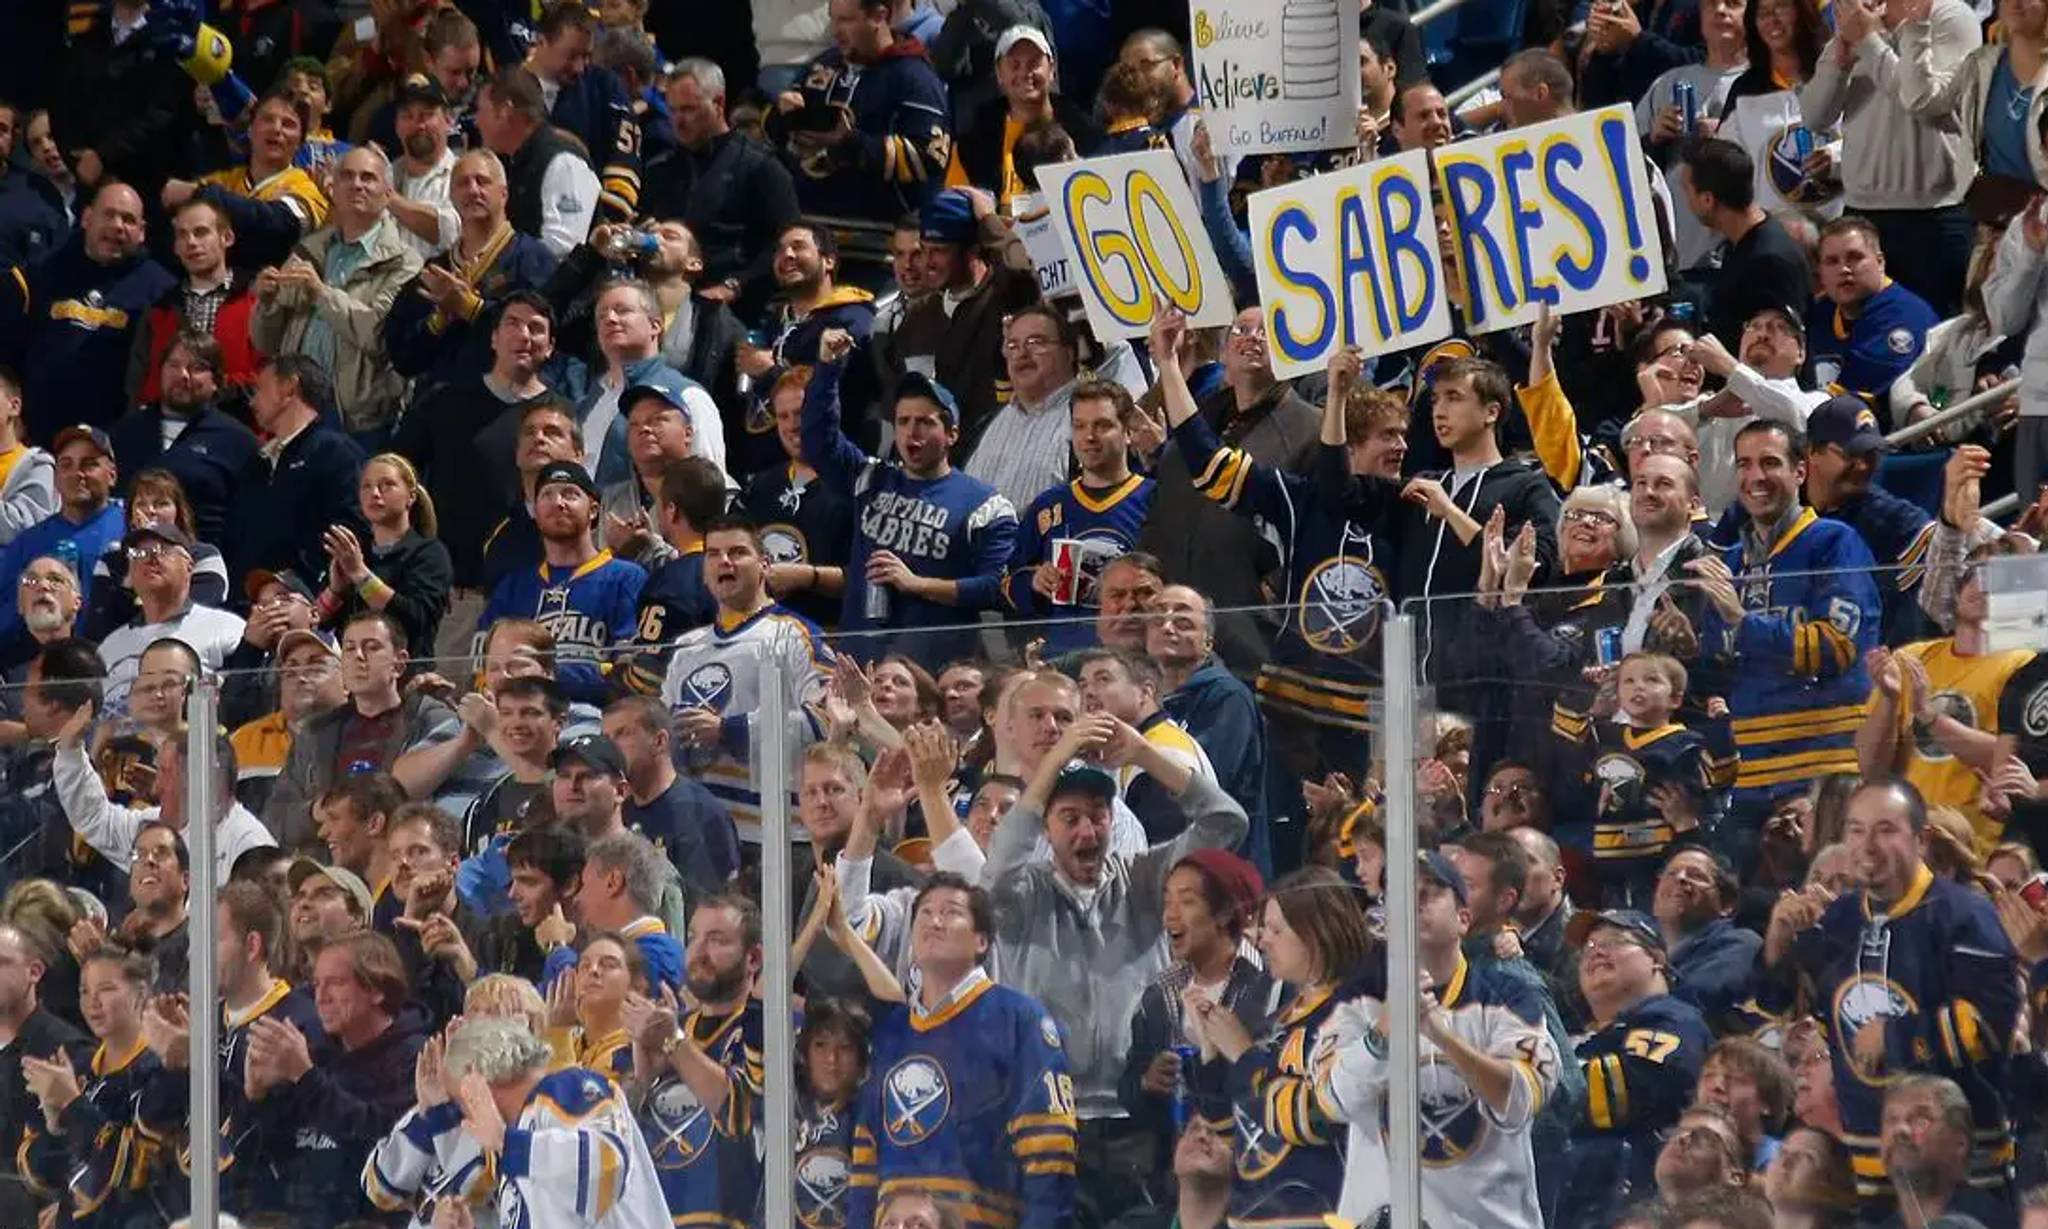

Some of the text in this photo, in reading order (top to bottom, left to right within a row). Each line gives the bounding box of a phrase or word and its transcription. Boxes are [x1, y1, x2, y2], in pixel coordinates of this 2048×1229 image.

[1200, 59, 1280, 109] Achieve
[1063, 170, 1203, 327] GO
[1625, 1029, 1682, 1064] 57
